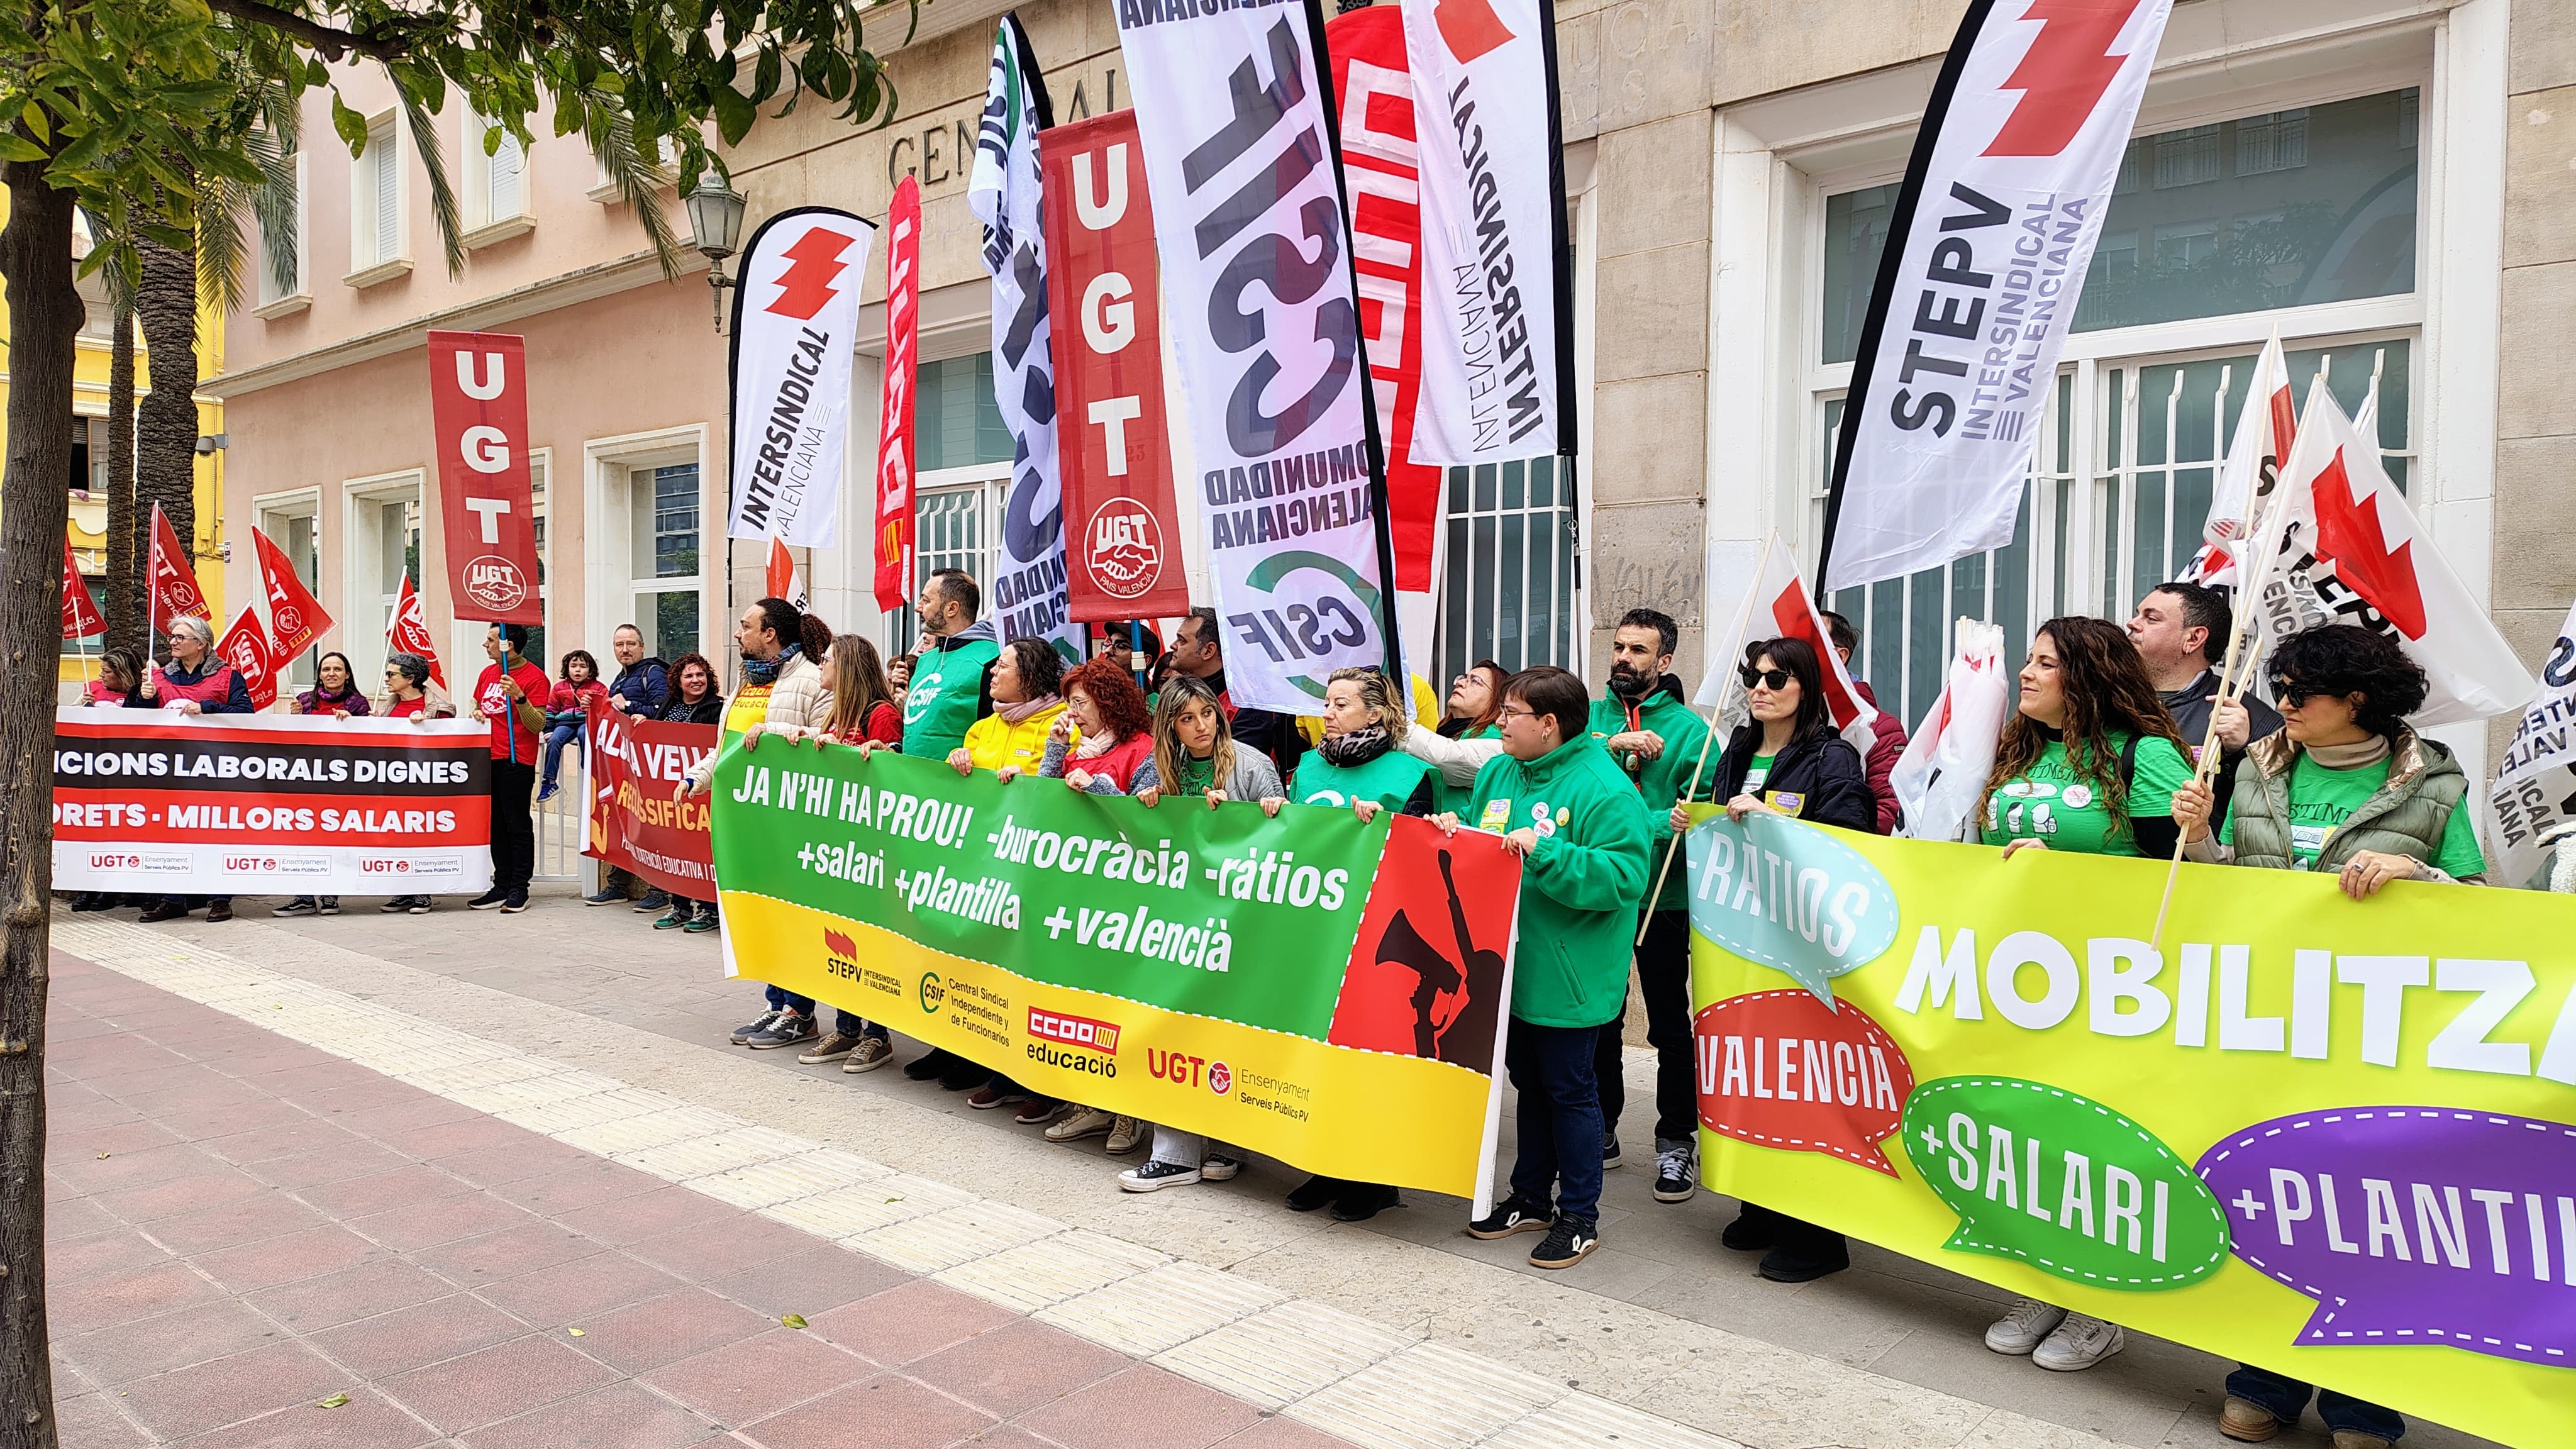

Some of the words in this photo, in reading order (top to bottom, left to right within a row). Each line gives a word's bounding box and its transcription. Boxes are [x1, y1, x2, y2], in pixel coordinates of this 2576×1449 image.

[1072, 142, 1141, 477] UGT
[1890, 180, 2012, 439] STEPV
[1960, 192, 2057, 440] INTERSINDICAL
[2004, 197, 2089, 402] VALENCIANA
[741, 326, 830, 531] INTERSINDICAL
[455, 350, 510, 544] UGT
[1096, 514, 1147, 550] UGT
[472, 565, 514, 584] UGT
[53, 750, 169, 777] ICIONS
[174, 754, 348, 783] LABORALS
[353, 760, 469, 784] DIGNES
[167, 804, 314, 831] MILLORS
[319, 808, 456, 833] SALARIS
[733, 765, 769, 806] JA
[779, 771, 830, 818] N'HI
[839, 780, 872, 827] HA
[876, 786, 974, 849] PROU!
[986, 814, 1189, 890] -burocràcia
[1204, 847, 1350, 912] -ràtios
[91, 855, 126, 868] UGT
[145, 856, 188, 865] Ensenyament
[226, 858, 260, 870] UGT
[282, 858, 327, 867] Ensenyament
[362, 859, 394, 872] UGT
[414, 860, 458, 868] Ensenyament
[662, 855, 704, 880] EDUCATIVA
[796, 840, 884, 890] +salari
[894, 865, 1020, 931] +plantilla
[1043, 903, 1233, 974] +valencià
[1686, 826, 1870, 958] -RÀTIOS
[828, 957, 862, 983] STEPV
[864, 969, 902, 988] INTERSINDICAL
[869, 979, 901, 997] VALENCIANA
[924, 983, 945, 1003] CSIF
[948, 977, 979, 998] Central
[980, 986, 1009, 1011] Sindical
[951, 994, 1004, 1026] Independiente
[951, 1013, 960, 1026] de
[962, 1016, 1010, 1048] Funcionarios
[1031, 1012, 1094, 1041] CCOO
[1026, 1043, 1117, 1079] educació
[1148, 1048, 1204, 1088] UGT
[1696, 1030, 1899, 1112] VALENCIÀ
[1241, 1069, 1310, 1102] Ensenyament
[1240, 1092, 1272, 1111] Serveis
[1274, 1101, 1298, 1119] Públics
[1298, 1109, 1309, 1123] PV
[1920, 1111, 2168, 1264] +SALARI
